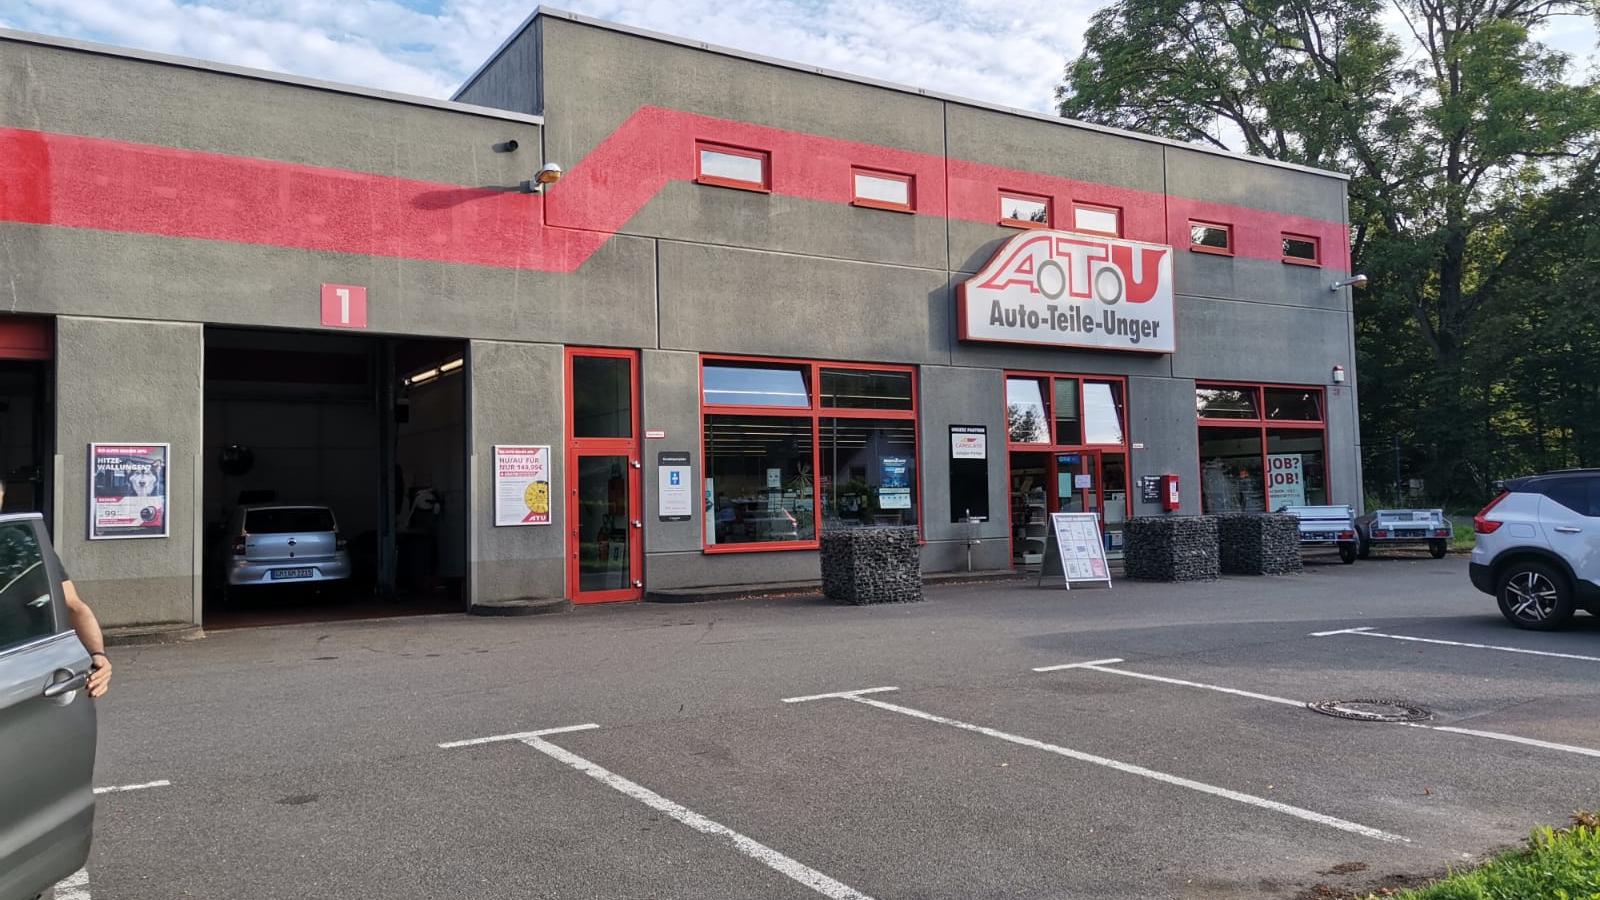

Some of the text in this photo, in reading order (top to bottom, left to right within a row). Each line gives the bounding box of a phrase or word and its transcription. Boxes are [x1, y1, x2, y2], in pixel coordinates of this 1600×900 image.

[335, 288, 350, 324] 1
[989, 299, 1160, 345] Auto-Teile-Unger
[1267, 457, 1300, 473] JOB?
[1268, 473, 1299, 488] JOB!
